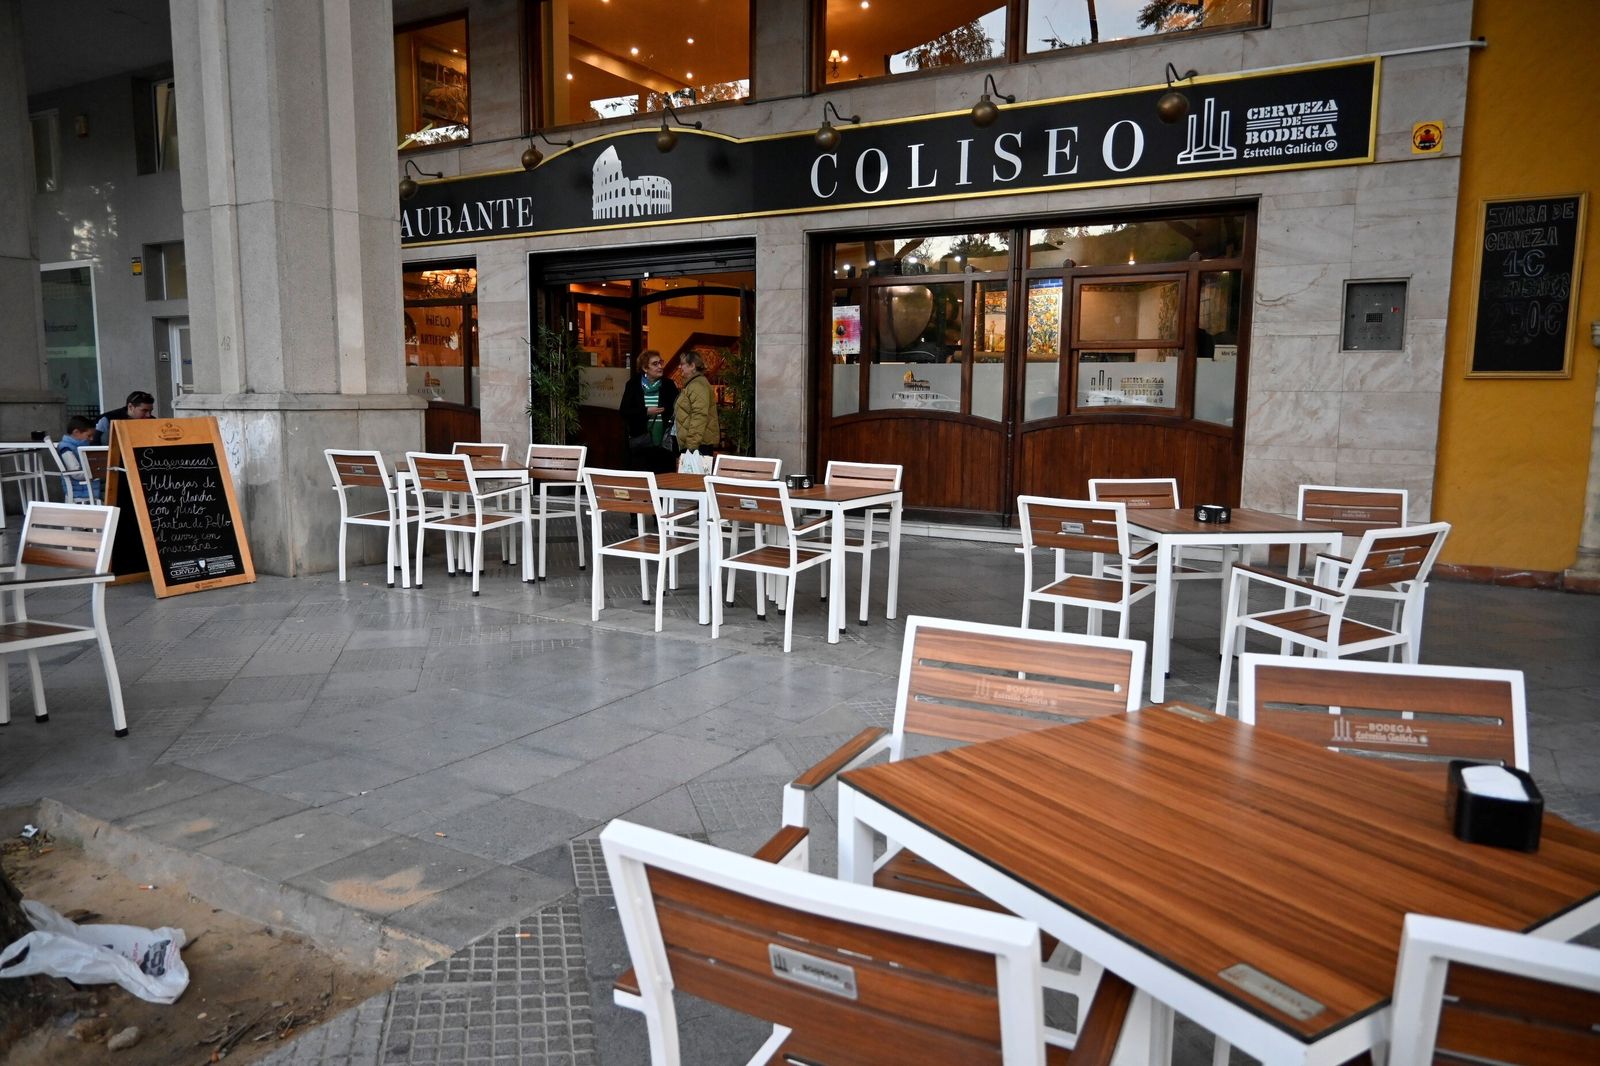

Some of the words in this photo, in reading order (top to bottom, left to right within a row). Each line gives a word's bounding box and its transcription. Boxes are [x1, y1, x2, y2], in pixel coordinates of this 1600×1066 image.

[1246, 99, 1338, 120] CERVEZA
[1281, 116, 1302, 127] DE
[1245, 123, 1337, 145] BODEGA
[810, 119, 1145, 199] COLISEO
[1243, 146, 1283, 158] Estrella
[1284, 142, 1322, 155] Galicia
[1485, 226, 1559, 251] CERVEZA
[141, 448, 214, 470] Sugerencias
[203, 476, 216, 488] de
[150, 506, 170, 516] con
